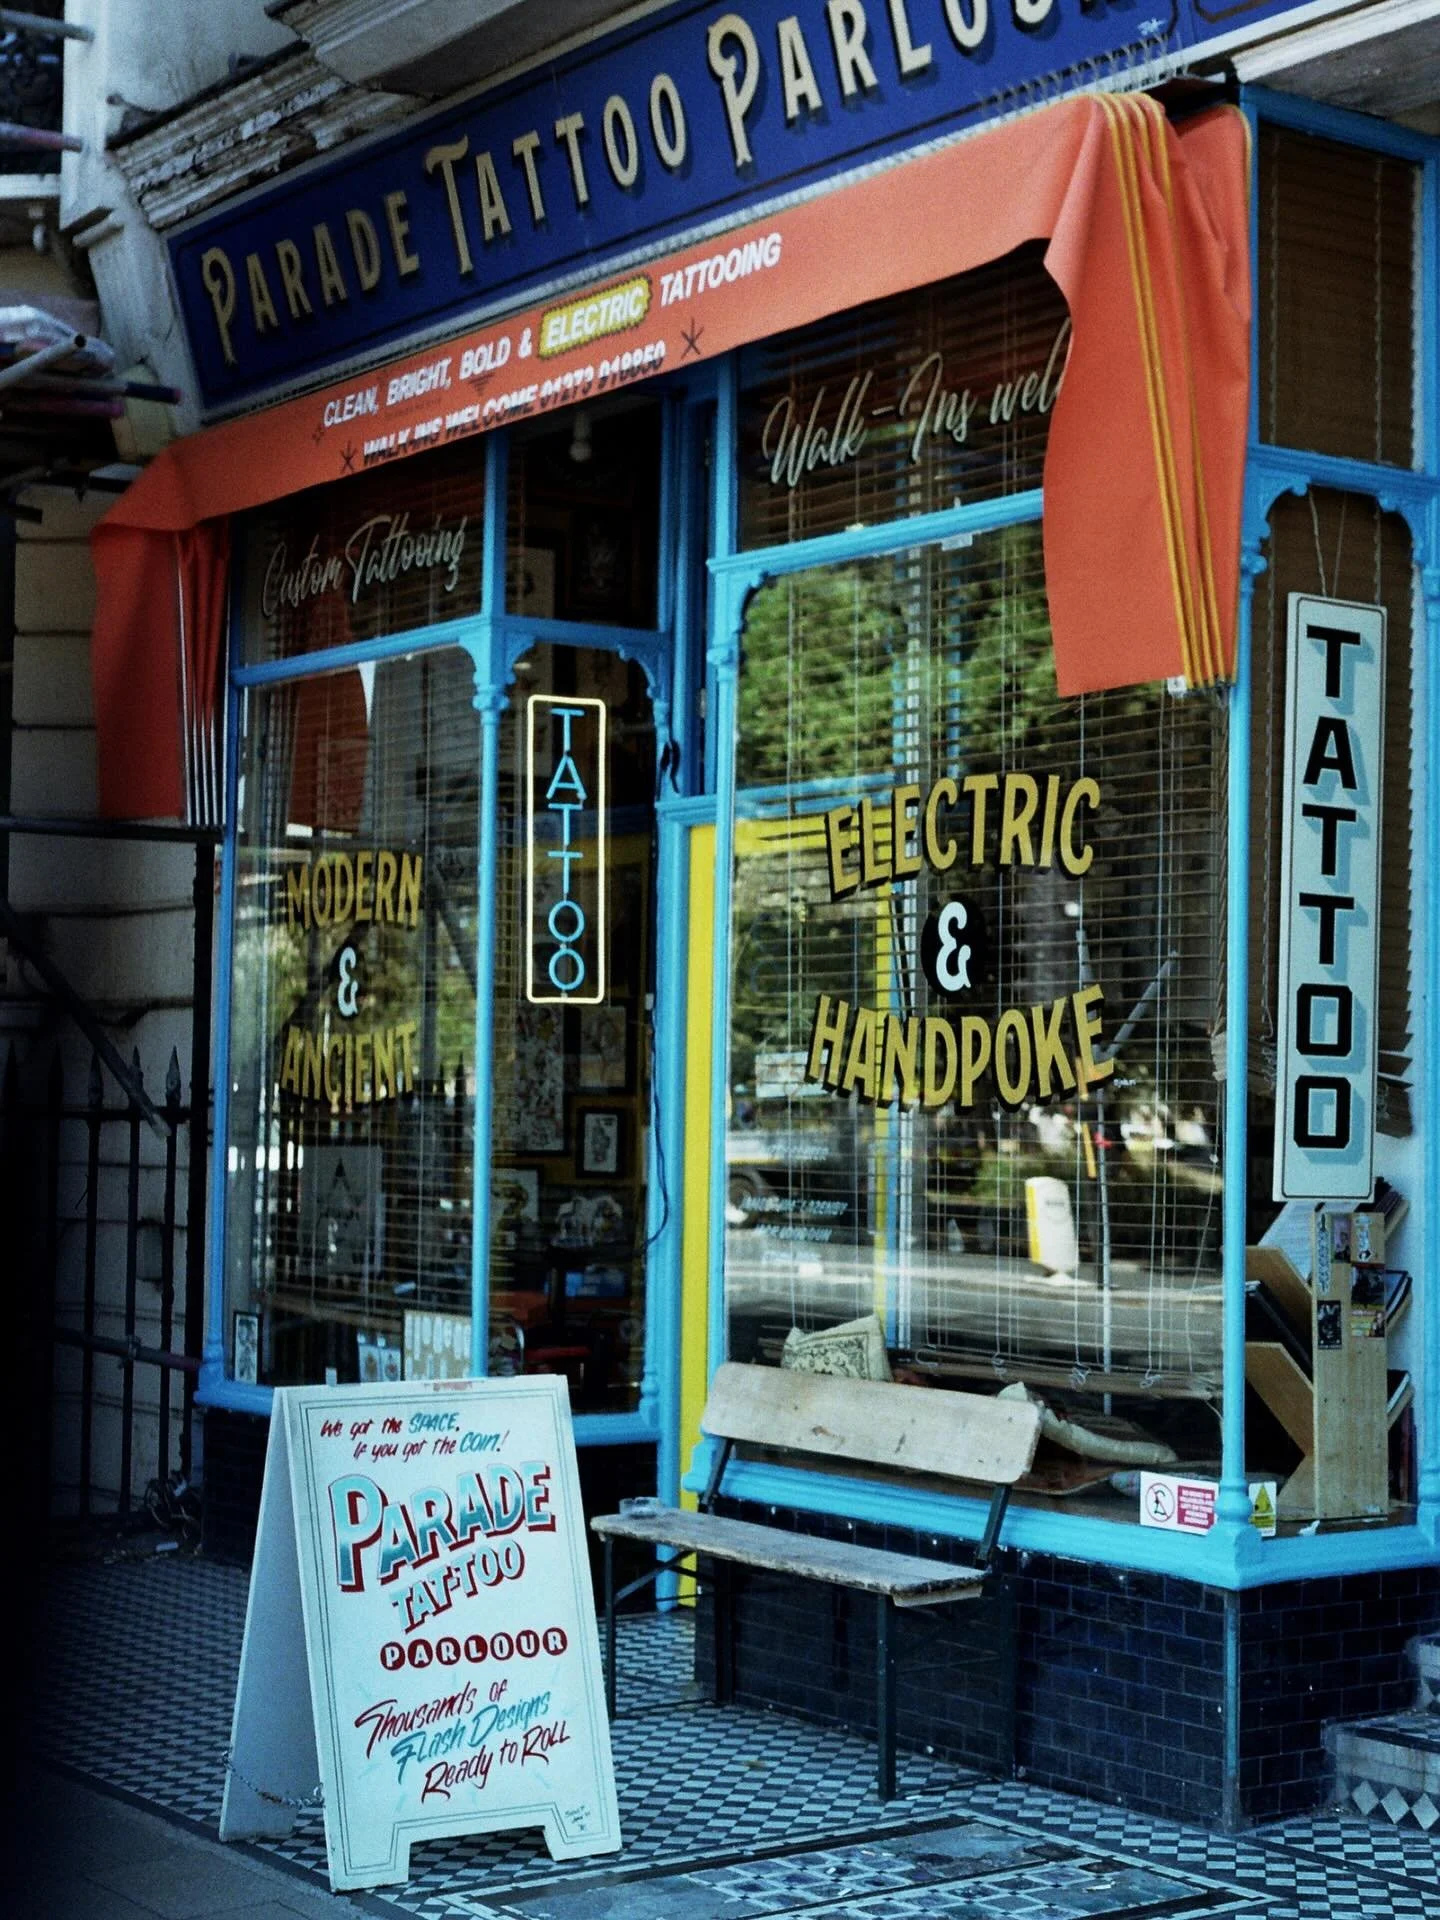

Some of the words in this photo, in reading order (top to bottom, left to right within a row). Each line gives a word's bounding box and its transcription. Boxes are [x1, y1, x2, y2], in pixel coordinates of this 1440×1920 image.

[202, 191, 419, 366] PARADE
[424, 73, 686, 275] TATTOO
[707, 0, 1135, 167] PARL
[323, 386, 379, 428] CLEAN,
[386, 357, 452, 405] BRIGHT,
[459, 335, 512, 380] BOLD
[517, 327, 533, 359] &
[546, 284, 645, 350] ELECTRIC
[660, 232, 782, 307] TATTOOING
[263, 534, 345, 617] Custom
[345, 512, 468, 604] Tattooing
[546, 708, 588, 990] TATTOO
[825, 773, 1100, 897] ELECTRIC
[286, 850, 423, 931] MODERN
[1294, 624, 1367, 1158] TATTOO
[337, 946, 359, 1017] &
[936, 900, 971, 992] &
[280, 1020, 417, 1105] ANCIENT
[807, 984, 1115, 1110] HANDPOKE
[320, 1419, 344, 1437] We
[350, 1418, 374, 1441] got
[408, 1411, 461, 1434] SPACE.
[371, 1441, 399, 1463] you
[402, 1440, 428, 1463] got
[327, 1460, 557, 1593] PARADE
[381, 1628, 568, 1671] PARLOUR
[354, 1680, 478, 1760] Thousands
[488, 1678, 508, 1702] of
[467, 1690, 552, 1749] Designs
[420, 1744, 494, 1805] Ready
[499, 1738, 518, 1767] to
